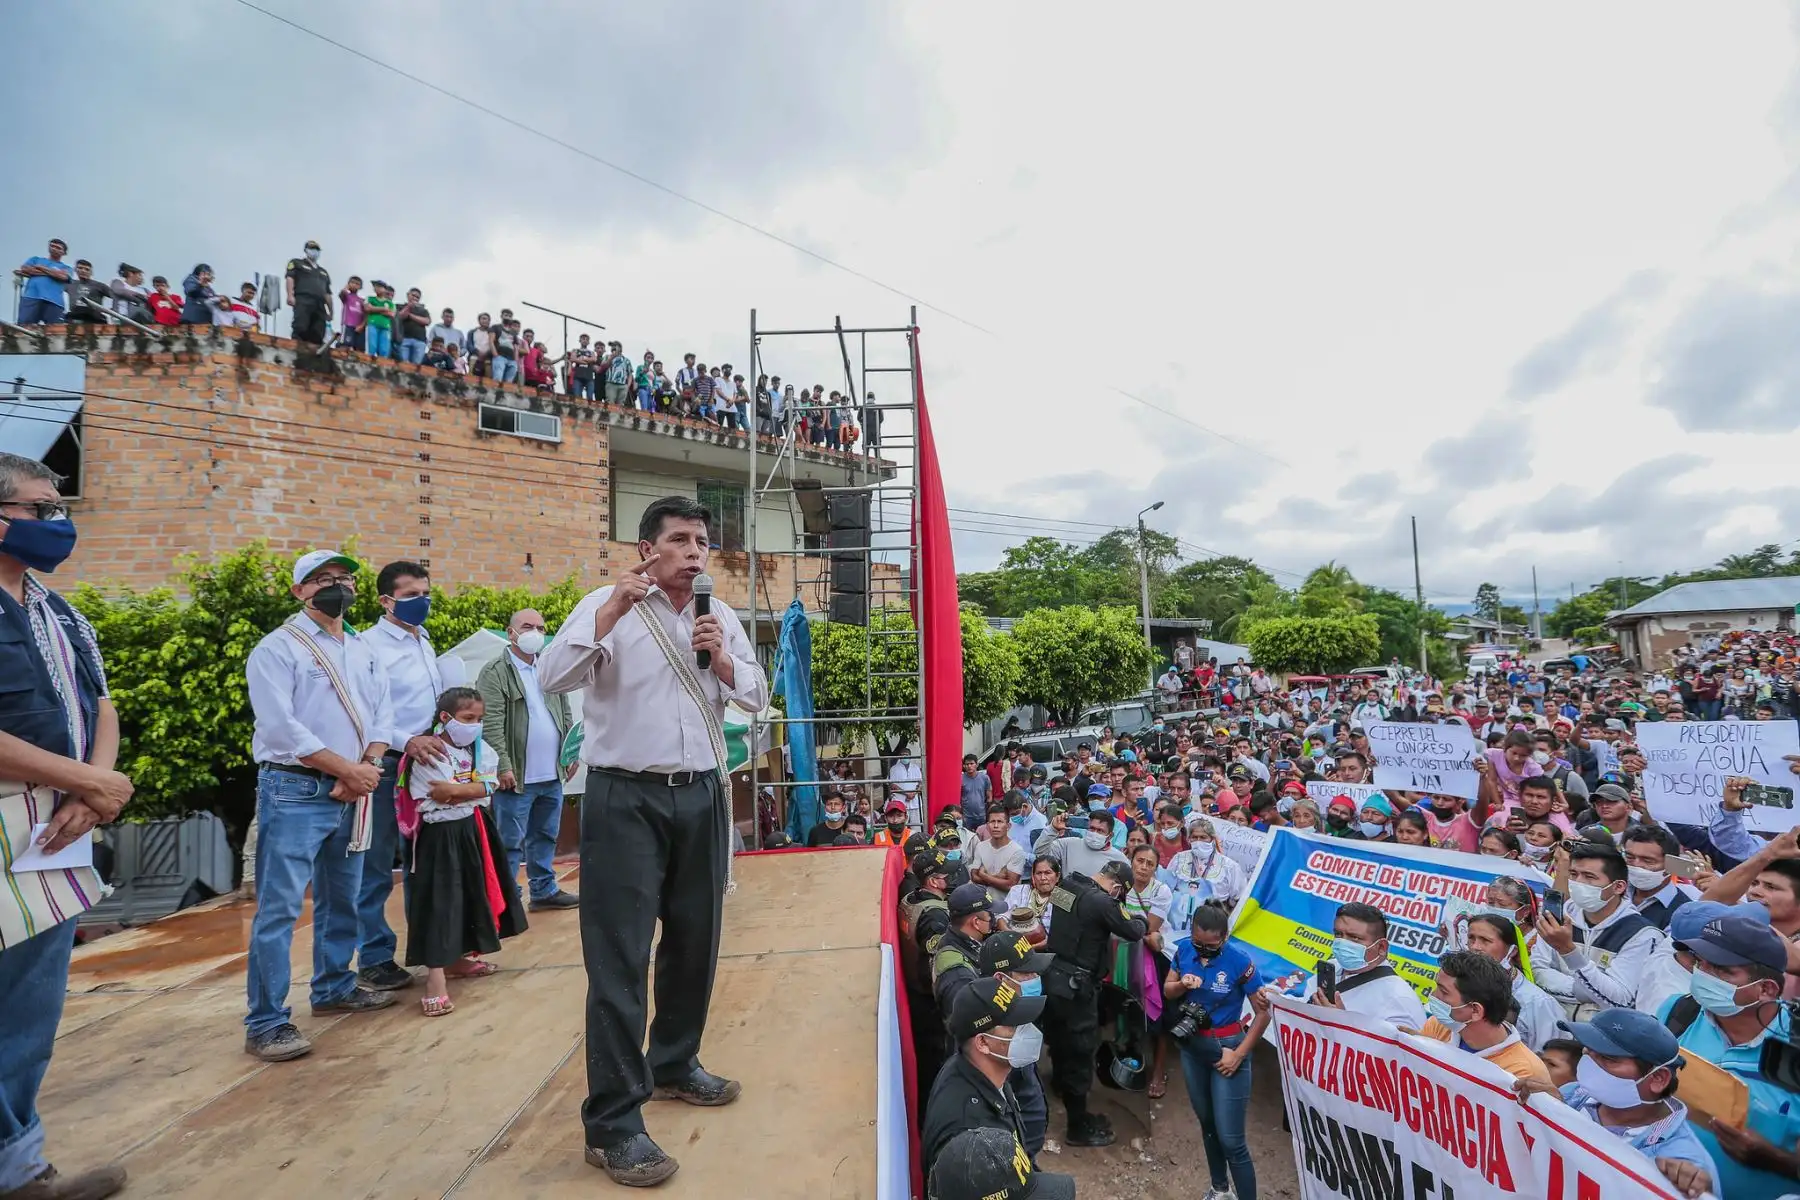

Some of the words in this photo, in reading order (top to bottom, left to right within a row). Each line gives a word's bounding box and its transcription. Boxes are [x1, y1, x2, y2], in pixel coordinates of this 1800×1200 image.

[1419, 727, 1439, 743] DEL
[1680, 724, 1764, 744] PRESIDENTE
[1395, 741, 1454, 755] CONGRESO
[1695, 745, 1770, 776] AGUA
[1310, 853, 1378, 882] COMITE
[1378, 867, 1402, 888] DE
[1293, 871, 1439, 924] ESTERILIZACIÓN
[973, 1014, 993, 1029] PERU
[1280, 1023, 1317, 1085] POR
[1317, 1037, 1341, 1097] LA
